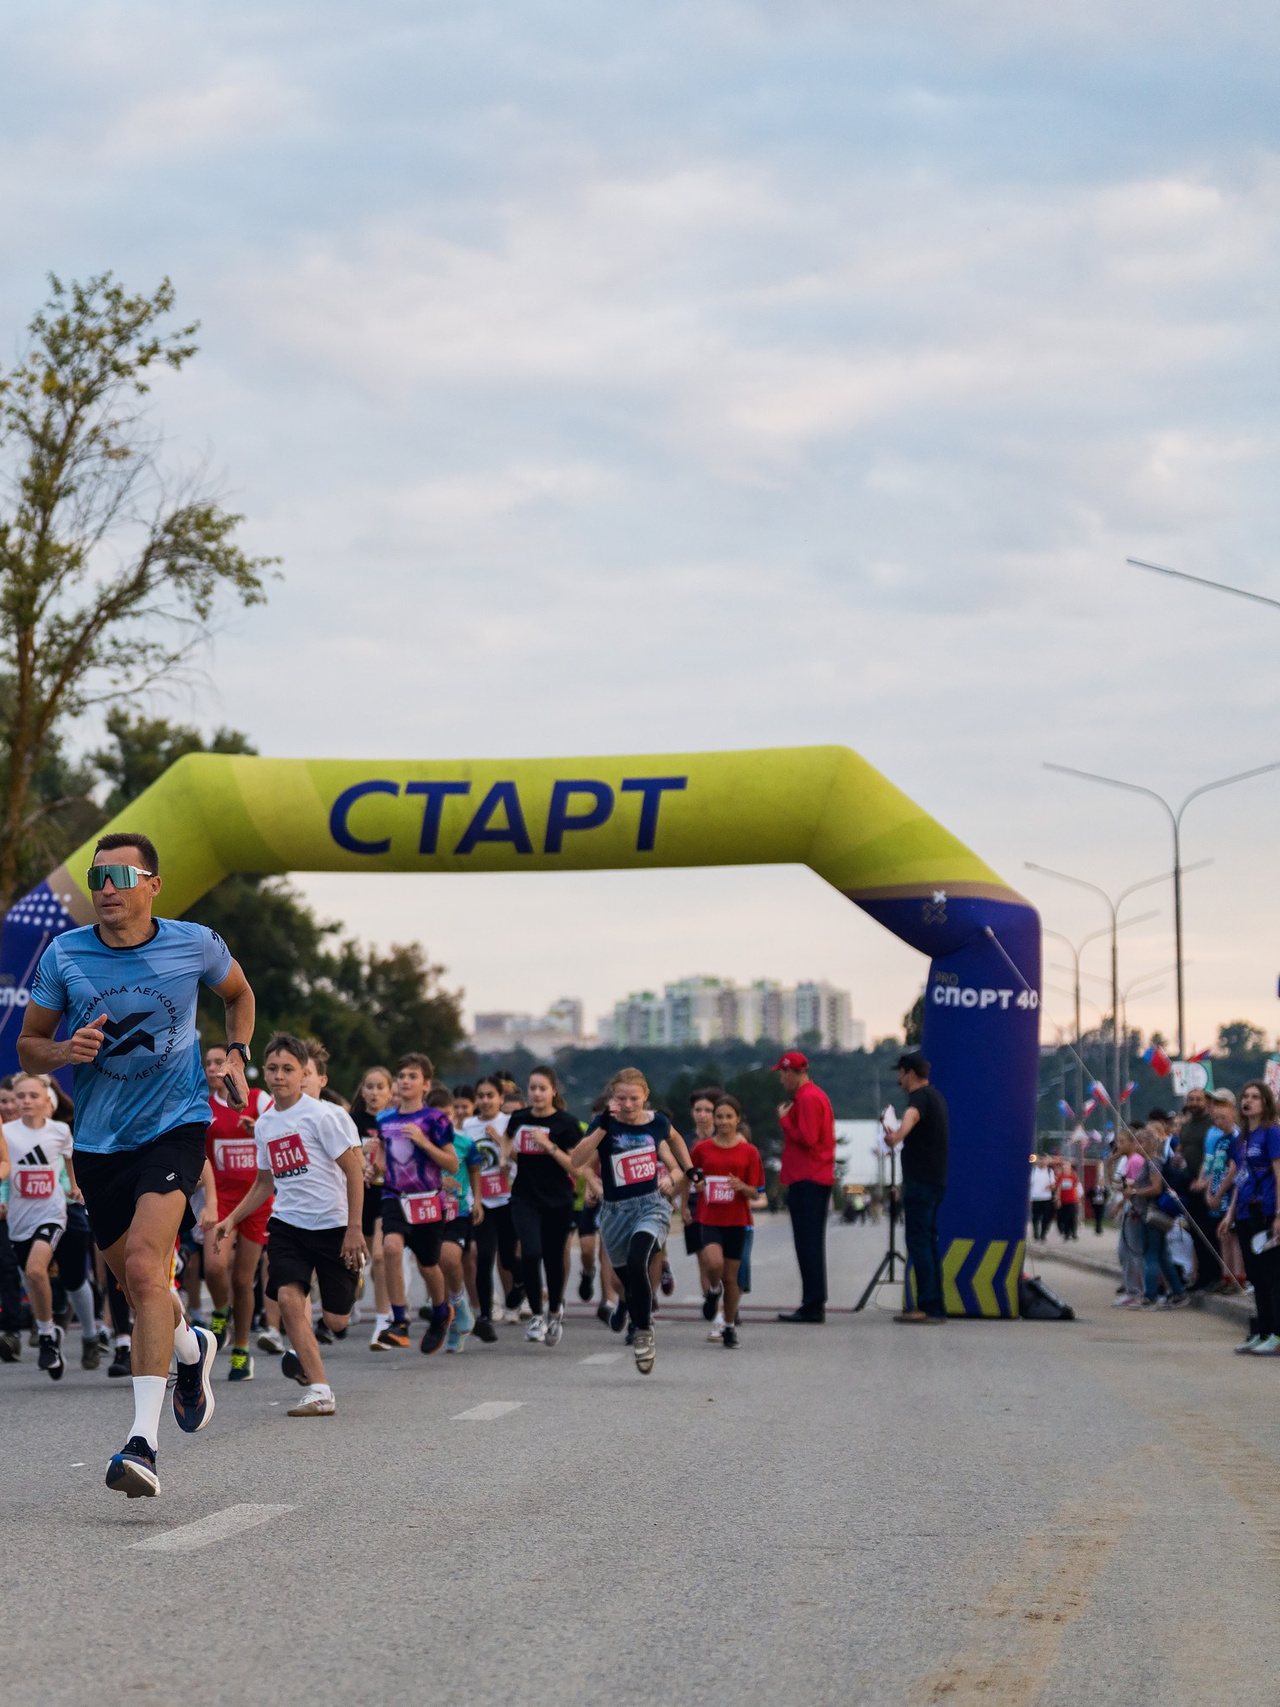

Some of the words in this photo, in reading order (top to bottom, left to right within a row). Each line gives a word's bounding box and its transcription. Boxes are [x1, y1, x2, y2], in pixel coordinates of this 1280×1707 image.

[329, 775, 688, 855] СТАРТ
[132, 985, 178, 1023] ЛЕГКОВА
[933, 985, 1014, 1010] СПОРТ
[1017, 989, 1038, 1010] 40
[134, 1038, 175, 1081] ЛЕГКОВА
[229, 1155, 255, 1168] 1136
[275, 1147, 304, 1168] 5114
[629, 1161, 656, 1179] 1239
[25, 1181, 53, 1194] 4704
